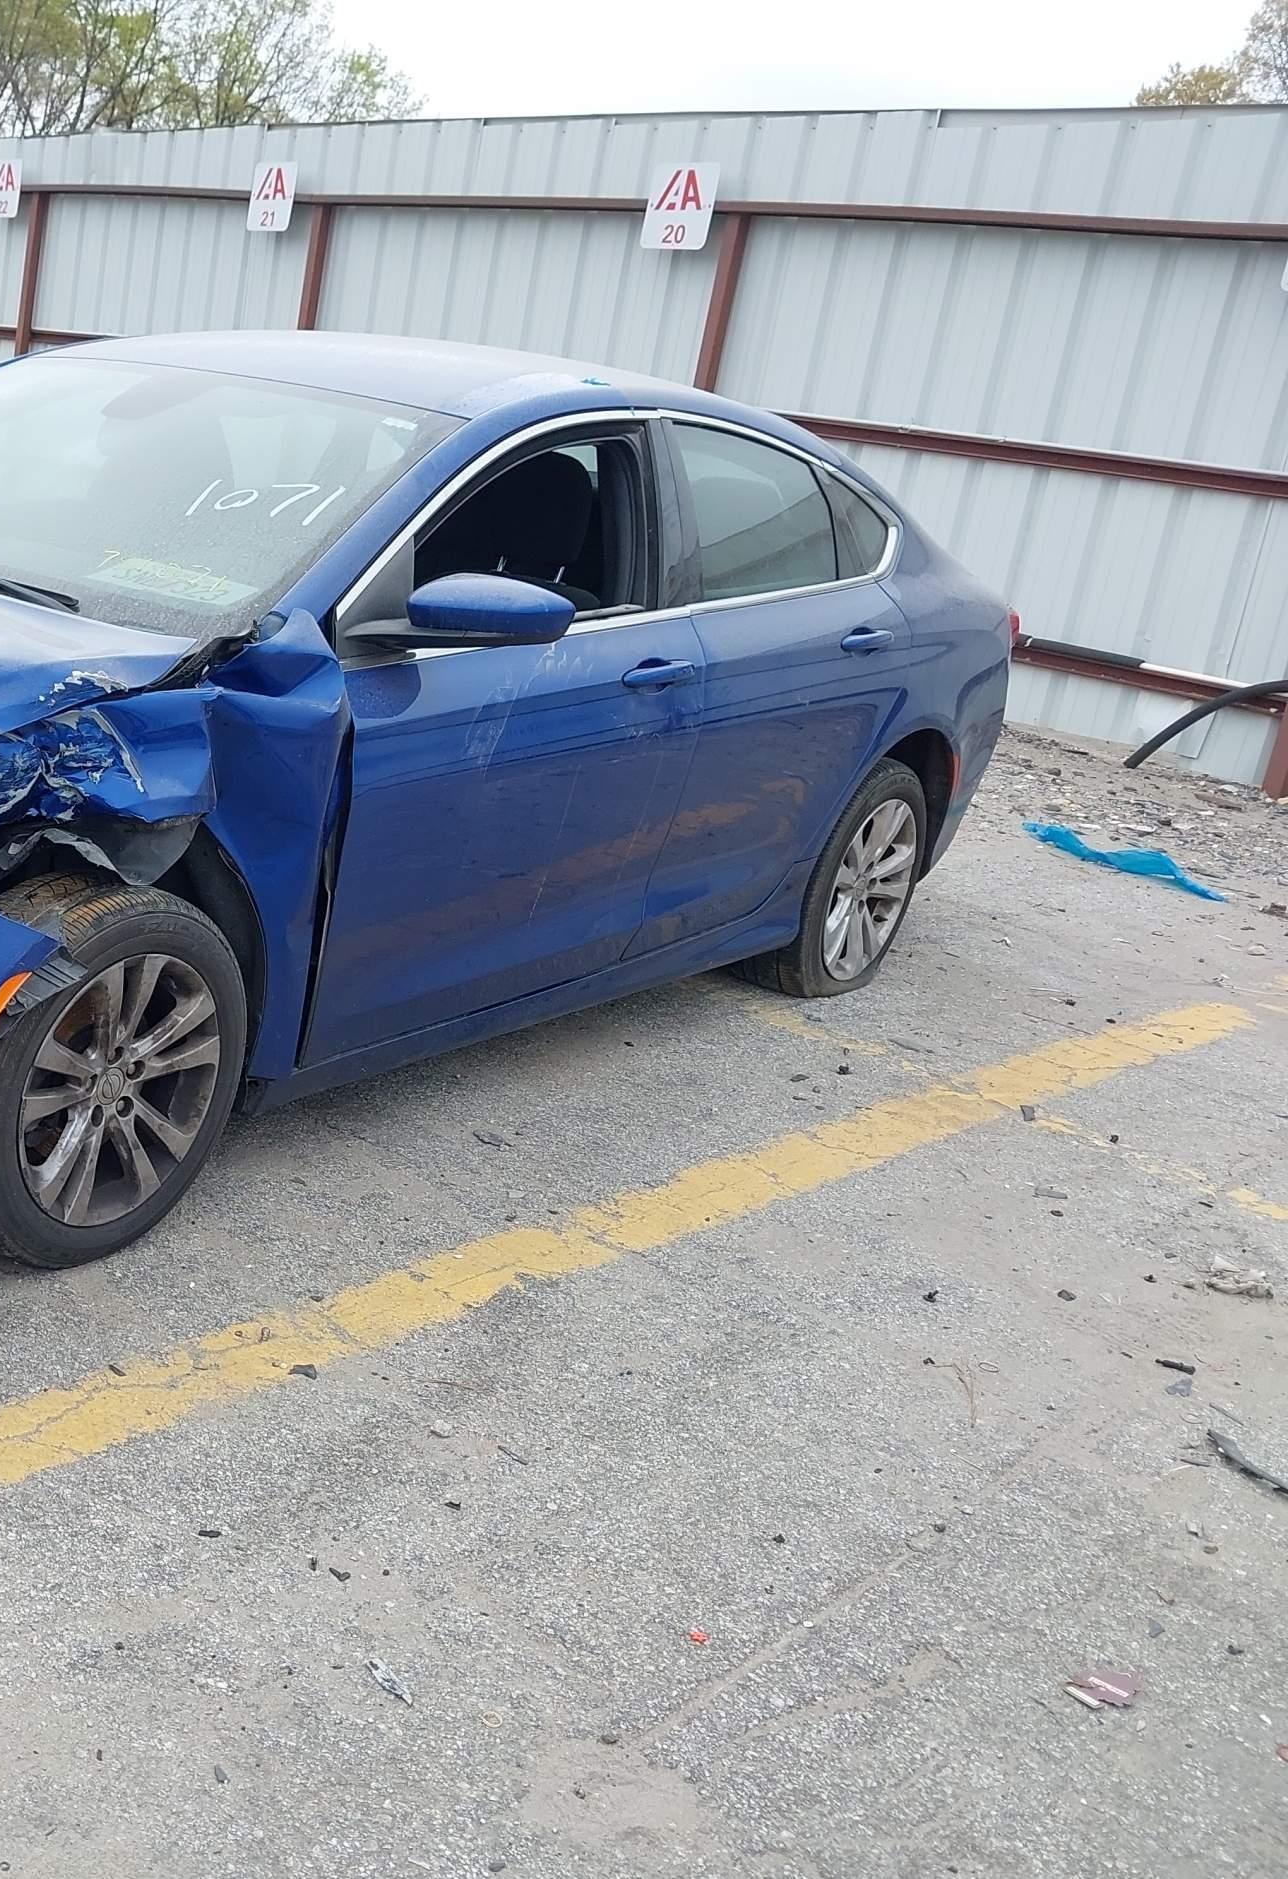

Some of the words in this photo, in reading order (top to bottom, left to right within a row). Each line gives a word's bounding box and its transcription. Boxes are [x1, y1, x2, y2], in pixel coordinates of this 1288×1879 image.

[260, 211, 275, 227] 21
[661, 224, 686, 244] 20
[185, 479, 346, 526] 1071
